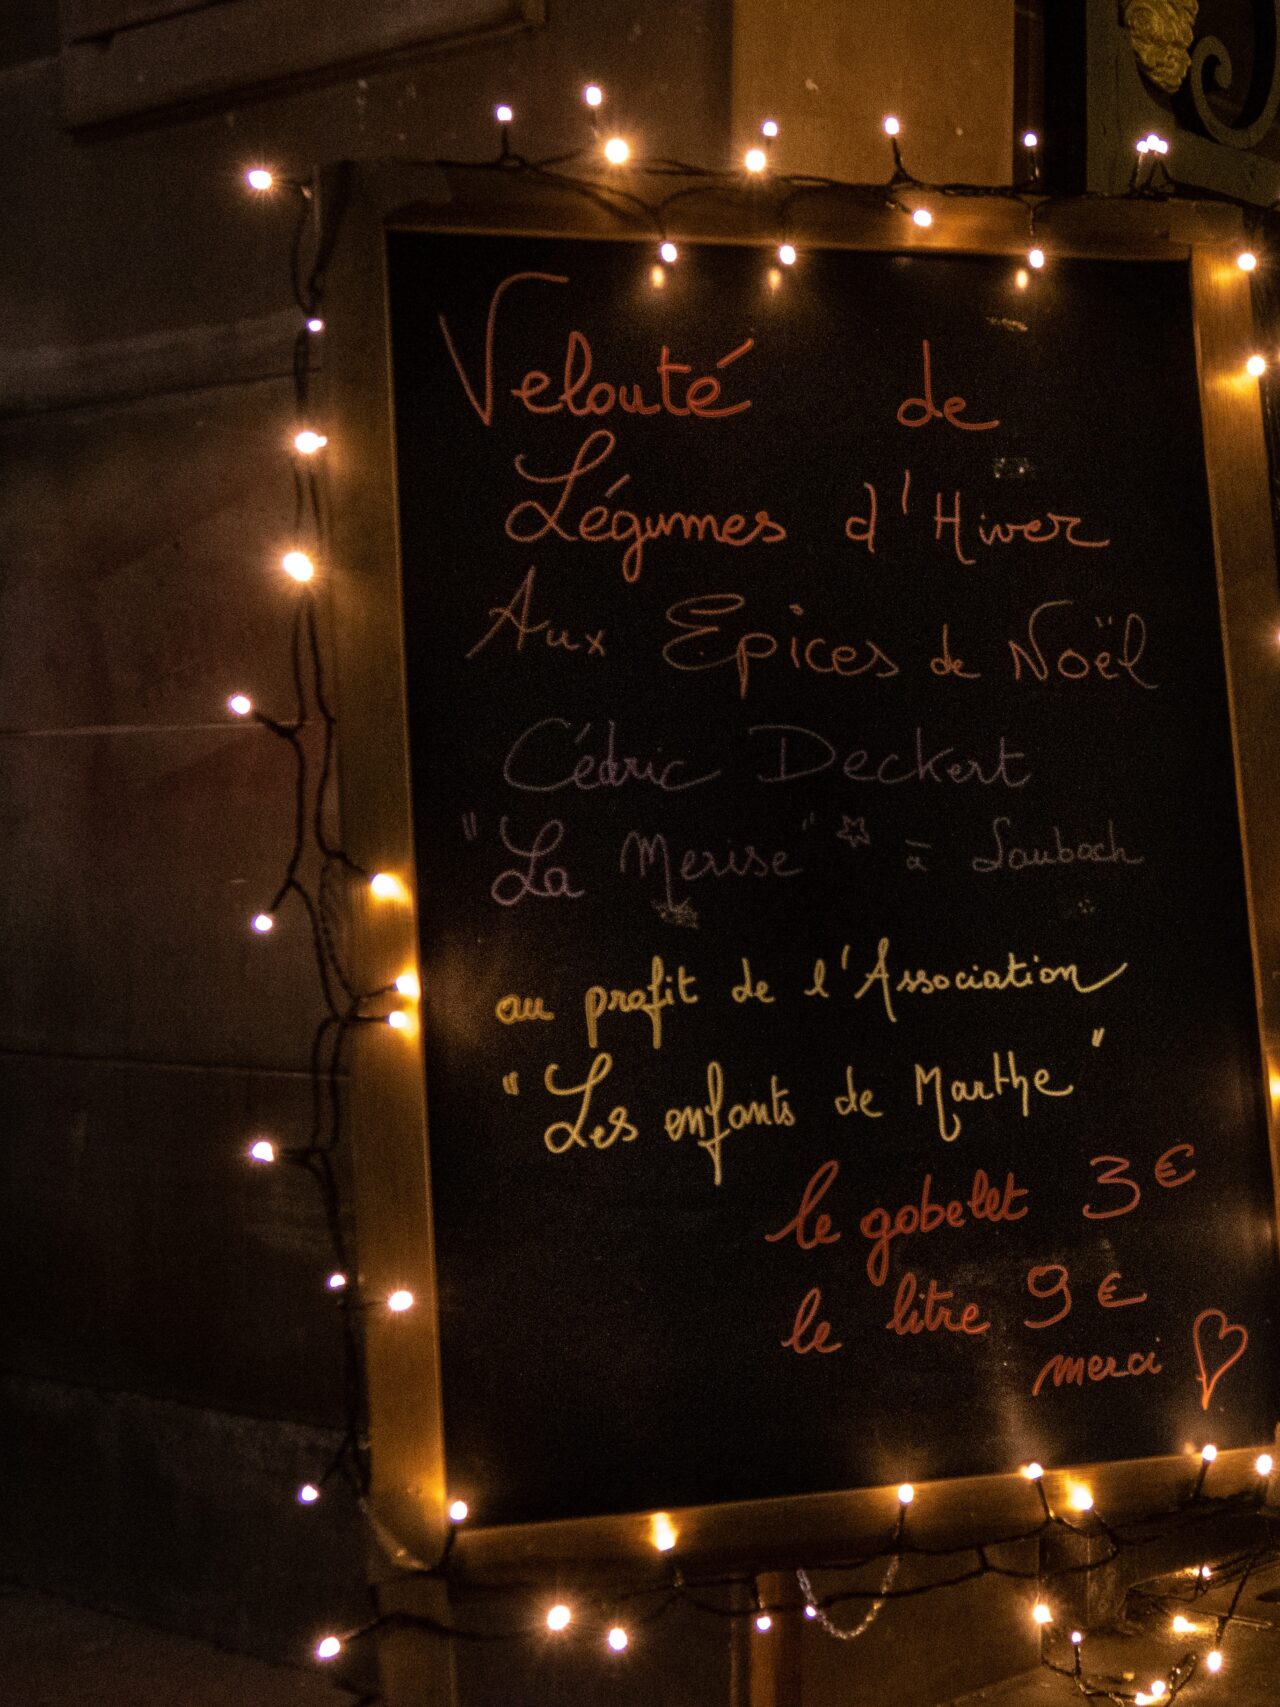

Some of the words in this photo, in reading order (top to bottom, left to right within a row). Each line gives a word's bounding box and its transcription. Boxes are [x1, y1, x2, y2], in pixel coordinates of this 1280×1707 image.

[439, 272, 754, 426] Velouté
[897, 340, 999, 430] de
[505, 430, 787, 583] Légumes
[846, 470, 1109, 564] d'Hiver
[466, 565, 605, 658] Aux
[662, 594, 899, 700] Epices
[930, 624, 981, 679] de
[1008, 600, 1159, 689] Noël
[503, 718, 721, 791] Cédric
[749, 725, 1031, 787] Deckert
[495, 994, 555, 1024] au
[585, 955, 698, 1049] profit
[731, 957, 776, 1003] de
[804, 937, 1127, 1023] l'Association
[664, 1062, 796, 1186] enfants
[834, 1065, 884, 1118] de
[764, 1160, 841, 1249] le
[860, 1168, 1029, 1287] gobelet
[781, 1287, 843, 1354] le
[886, 1272, 991, 1335] litre
[1032, 1349, 1162, 1397] merci
